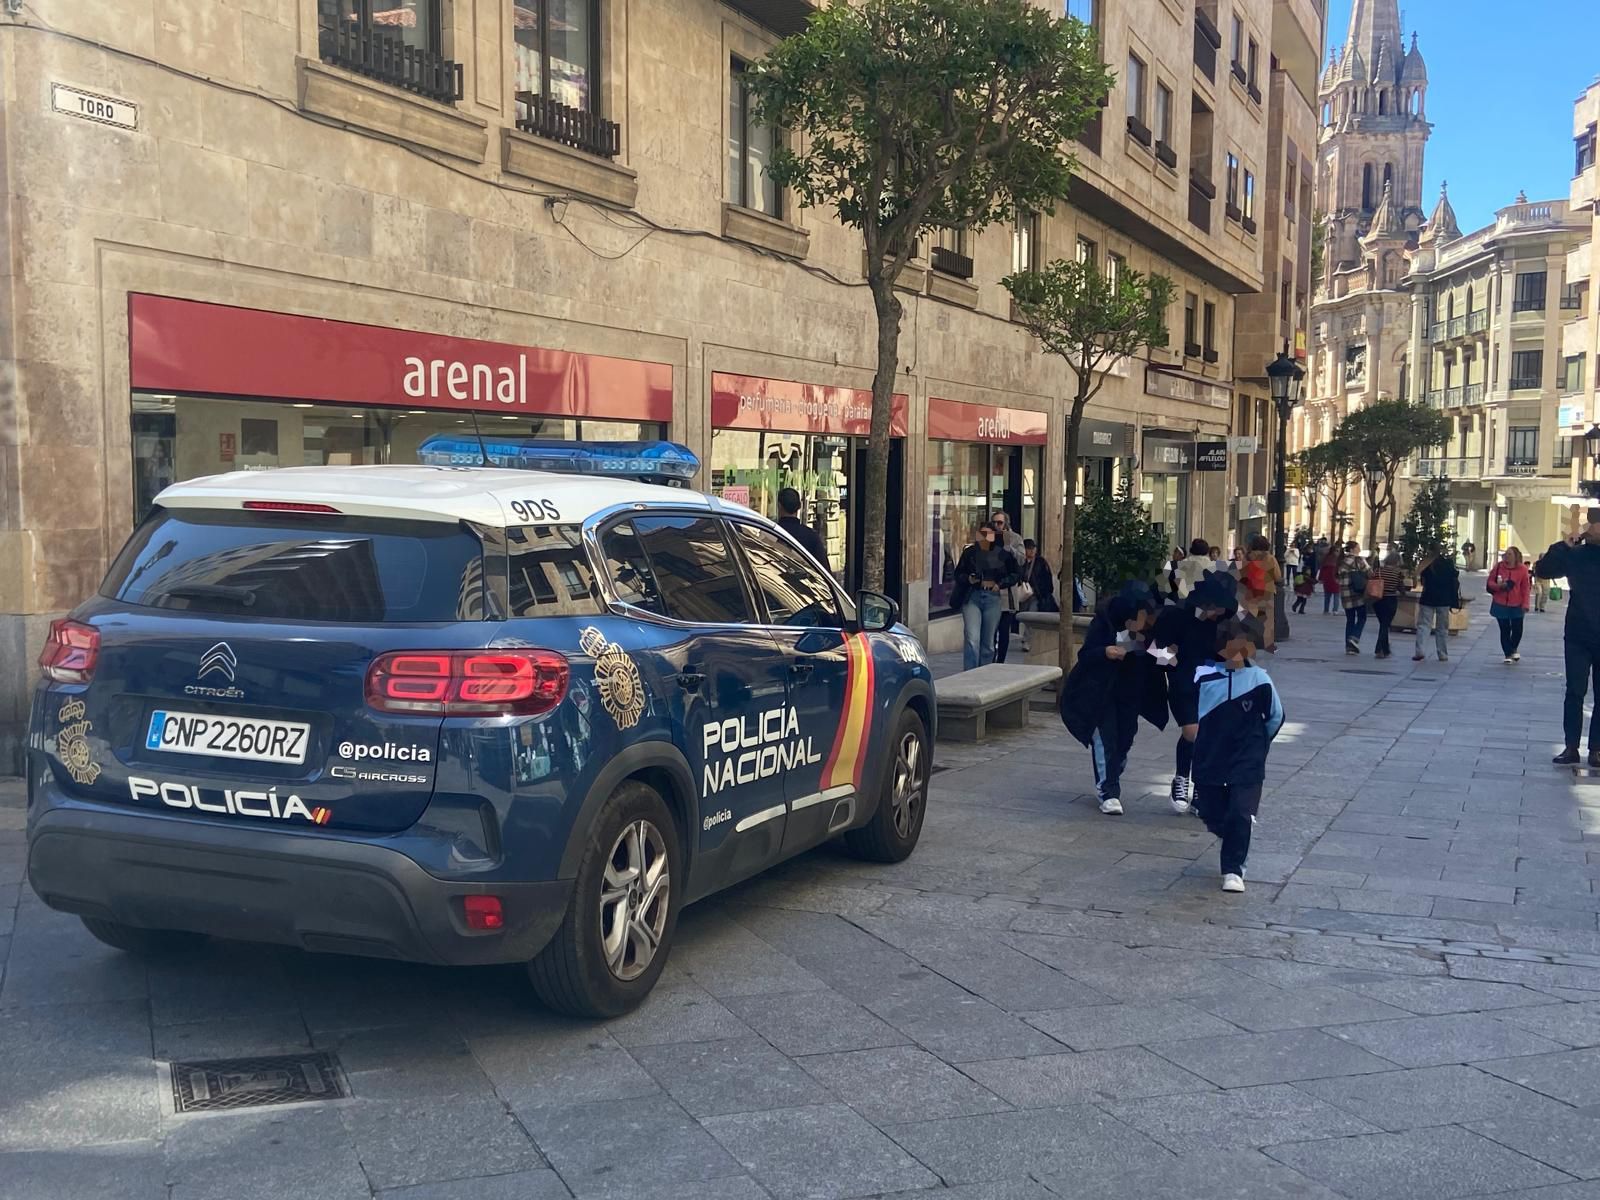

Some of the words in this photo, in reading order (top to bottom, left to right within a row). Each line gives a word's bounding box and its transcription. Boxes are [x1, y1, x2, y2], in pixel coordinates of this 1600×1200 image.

[78, 97, 114, 119] TORO
[403, 354, 526, 404] arenal
[844, 402, 872, 420] parafar
[511, 499, 560, 522] 9DS
[703, 701, 800, 760] POLICÍA
[338, 741, 431, 762] @policia
[331, 766, 357, 778] C5
[358, 772, 427, 783] AIRCROSS
[703, 736, 821, 798] NACIONAL
[128, 776, 314, 821] POLICÍA
[703, 808, 732, 831] @policia
